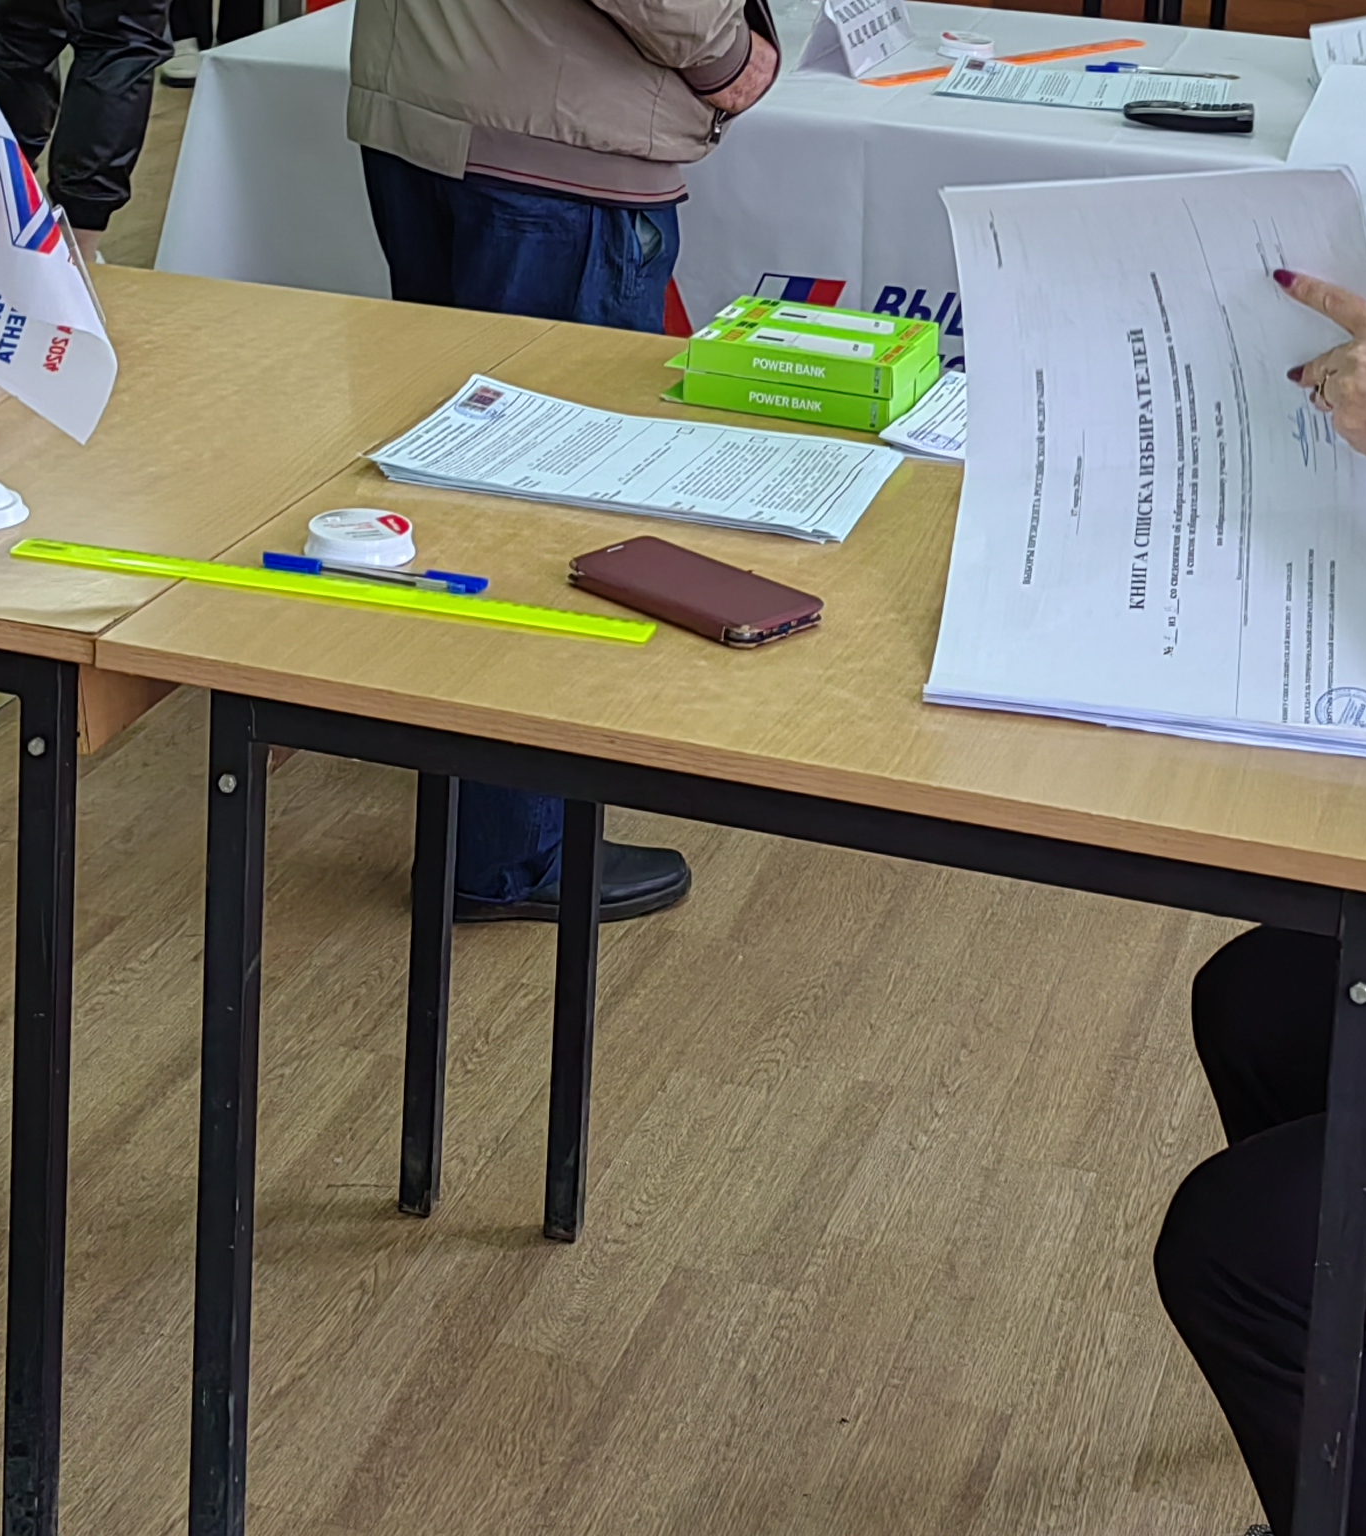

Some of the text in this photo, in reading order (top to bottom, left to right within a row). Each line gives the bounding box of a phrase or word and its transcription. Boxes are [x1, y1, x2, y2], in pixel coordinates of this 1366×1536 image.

[752, 357, 826, 378] POWER BANK
[748, 390, 822, 412] POWER BANK
[1127, 327, 1155, 610] КНИГА СПИСКА ИЗБИРАТЕЛЕЙ
